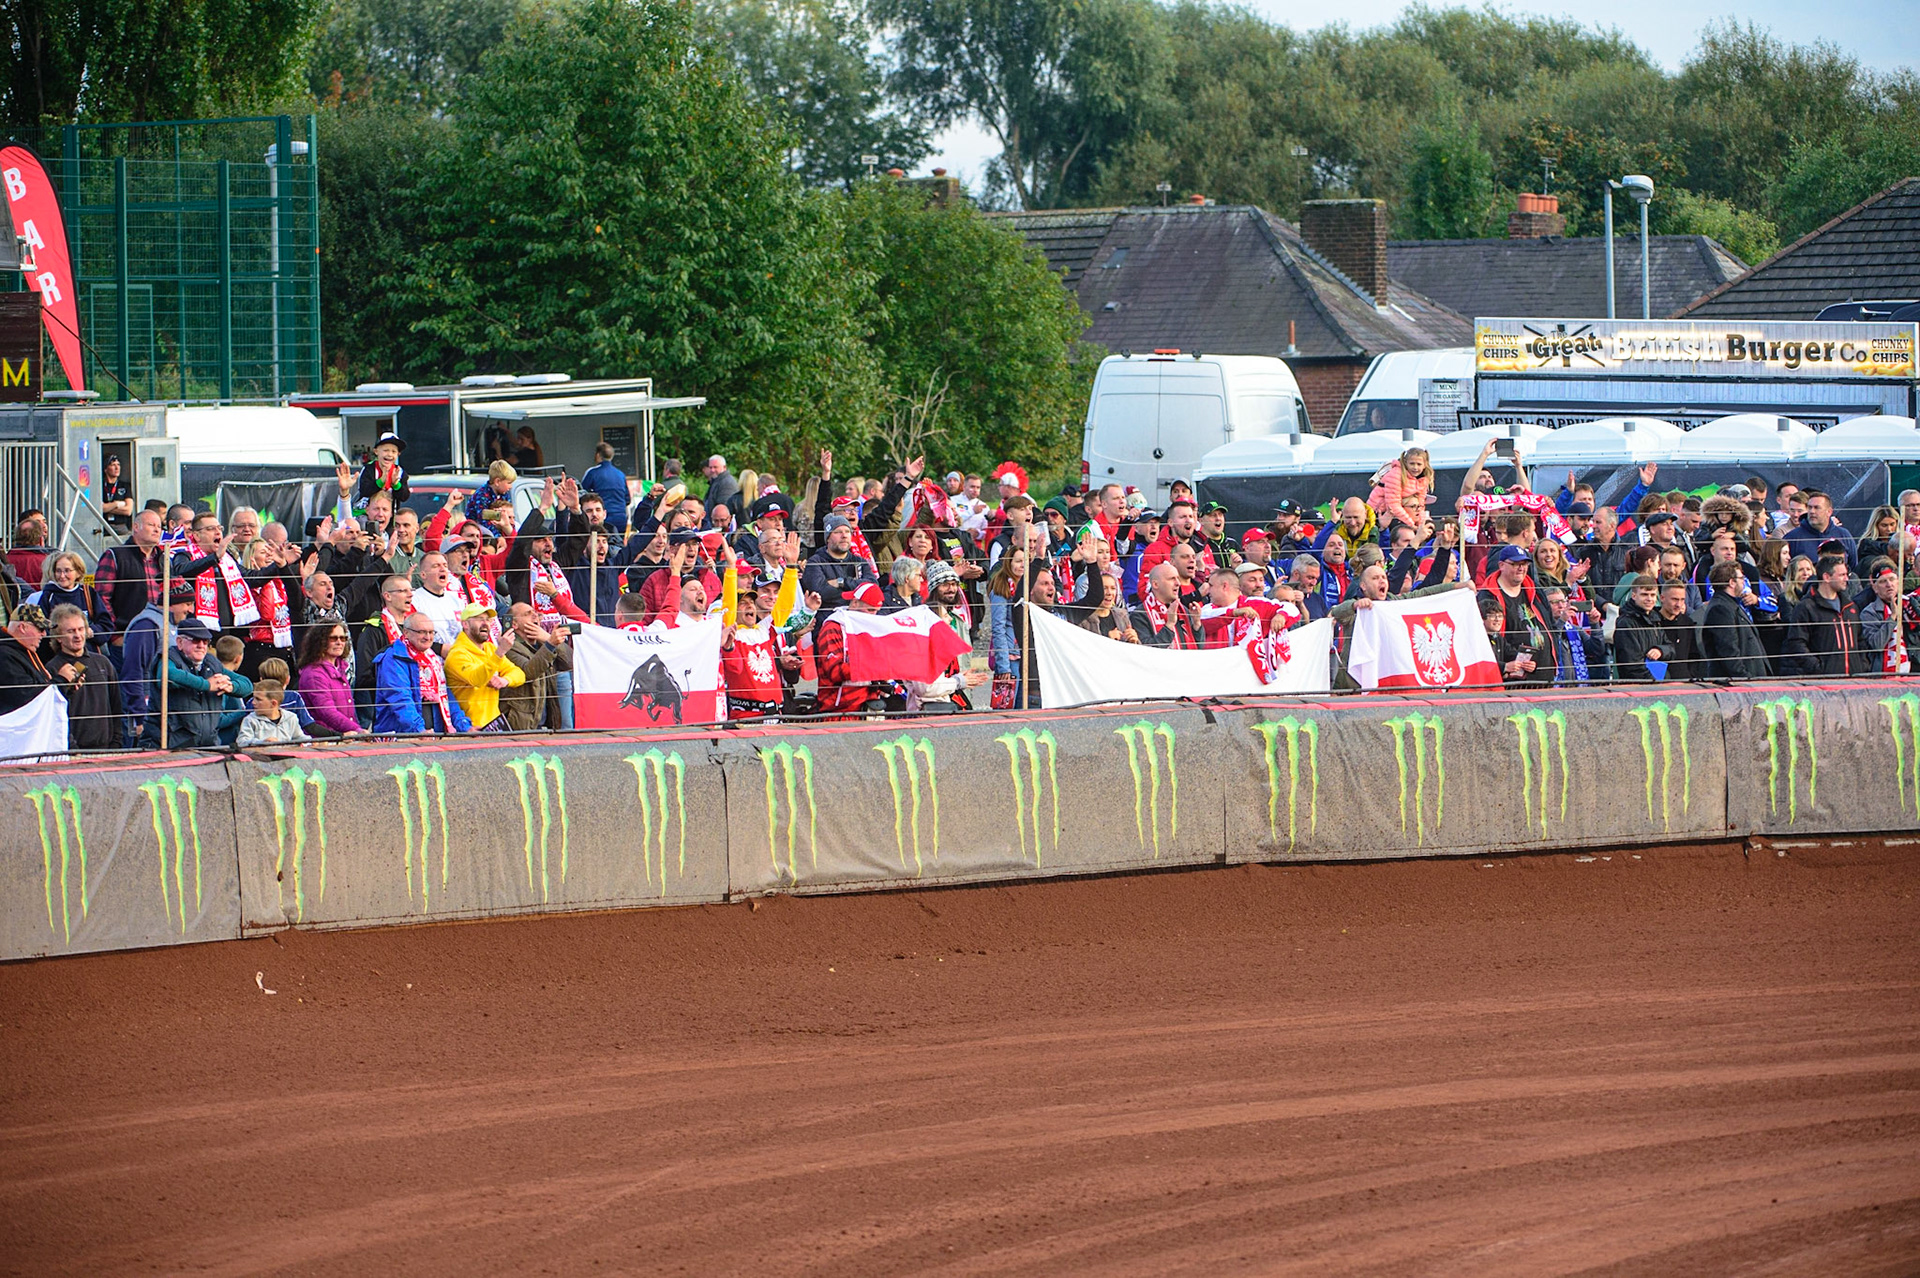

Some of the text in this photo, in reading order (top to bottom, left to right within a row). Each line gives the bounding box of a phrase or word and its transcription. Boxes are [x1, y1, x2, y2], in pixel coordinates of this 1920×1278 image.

[3, 167, 62, 307] BAR
[1483, 335, 1518, 345] CHUNKY
[1872, 339, 1909, 349] CHUNKY
[1483, 349, 1519, 358] CHIPS
[1532, 332, 1867, 369] Great British Burger Co
[1872, 353, 1909, 363] CHIPS
